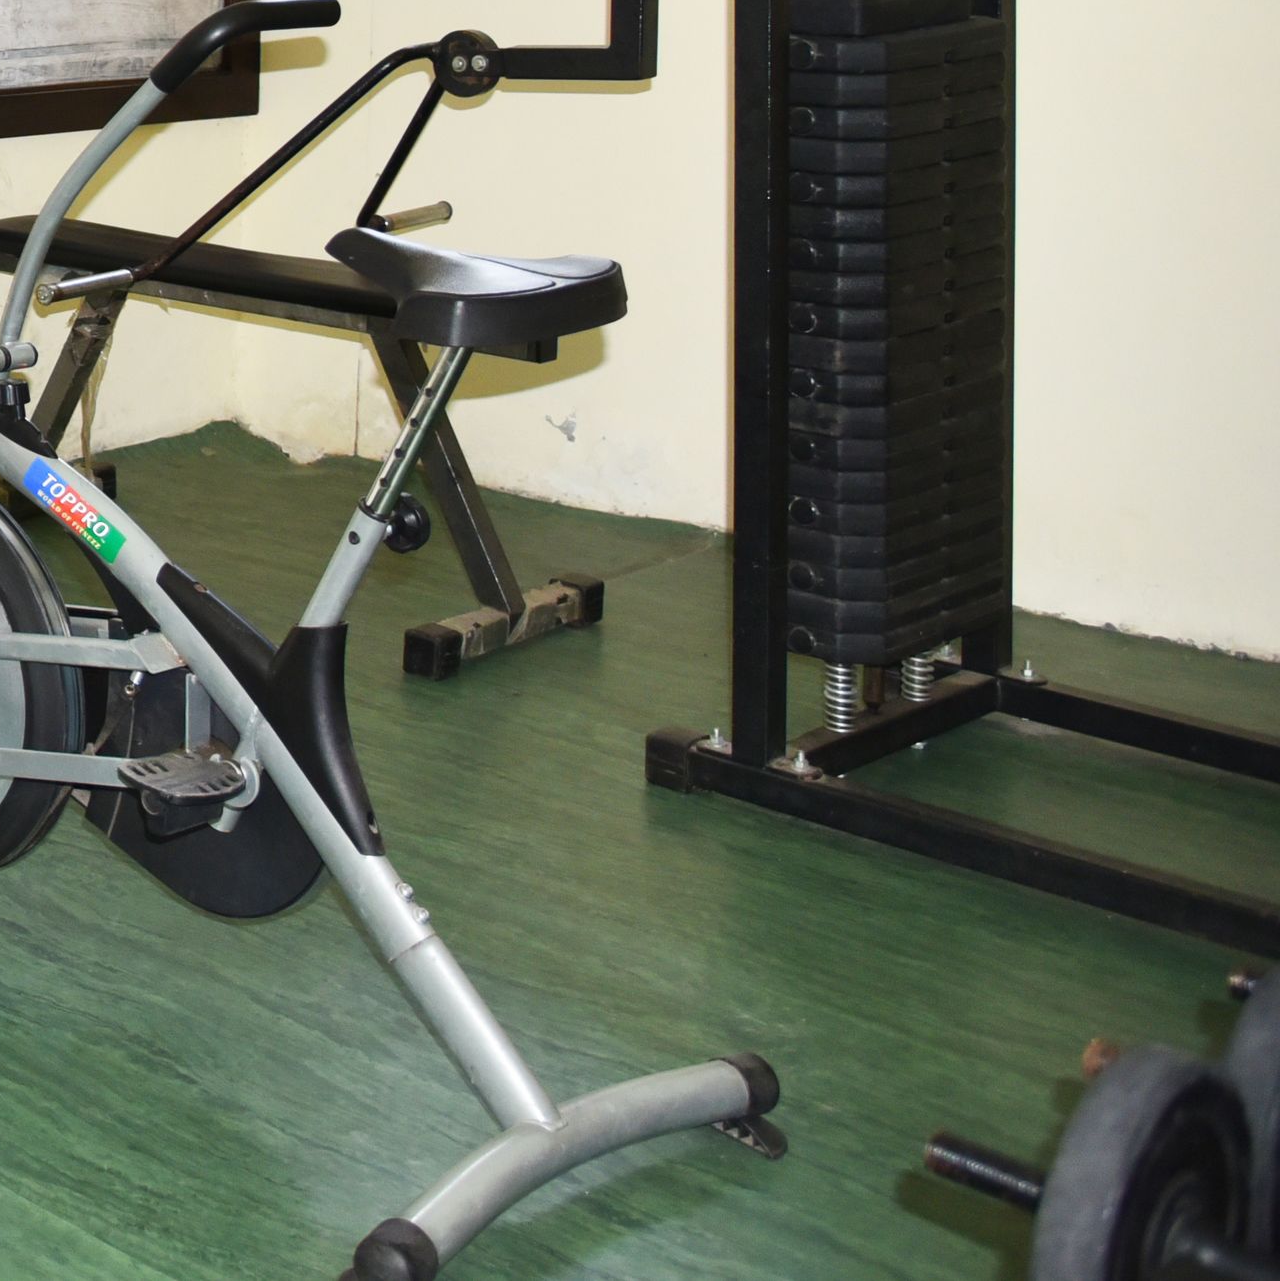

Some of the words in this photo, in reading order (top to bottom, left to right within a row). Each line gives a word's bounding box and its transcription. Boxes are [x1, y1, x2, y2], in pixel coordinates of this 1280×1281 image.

[37, 489, 62, 514] WORLD
[61, 512, 72, 522] OF
[41, 473, 109, 537] TOPPRO
